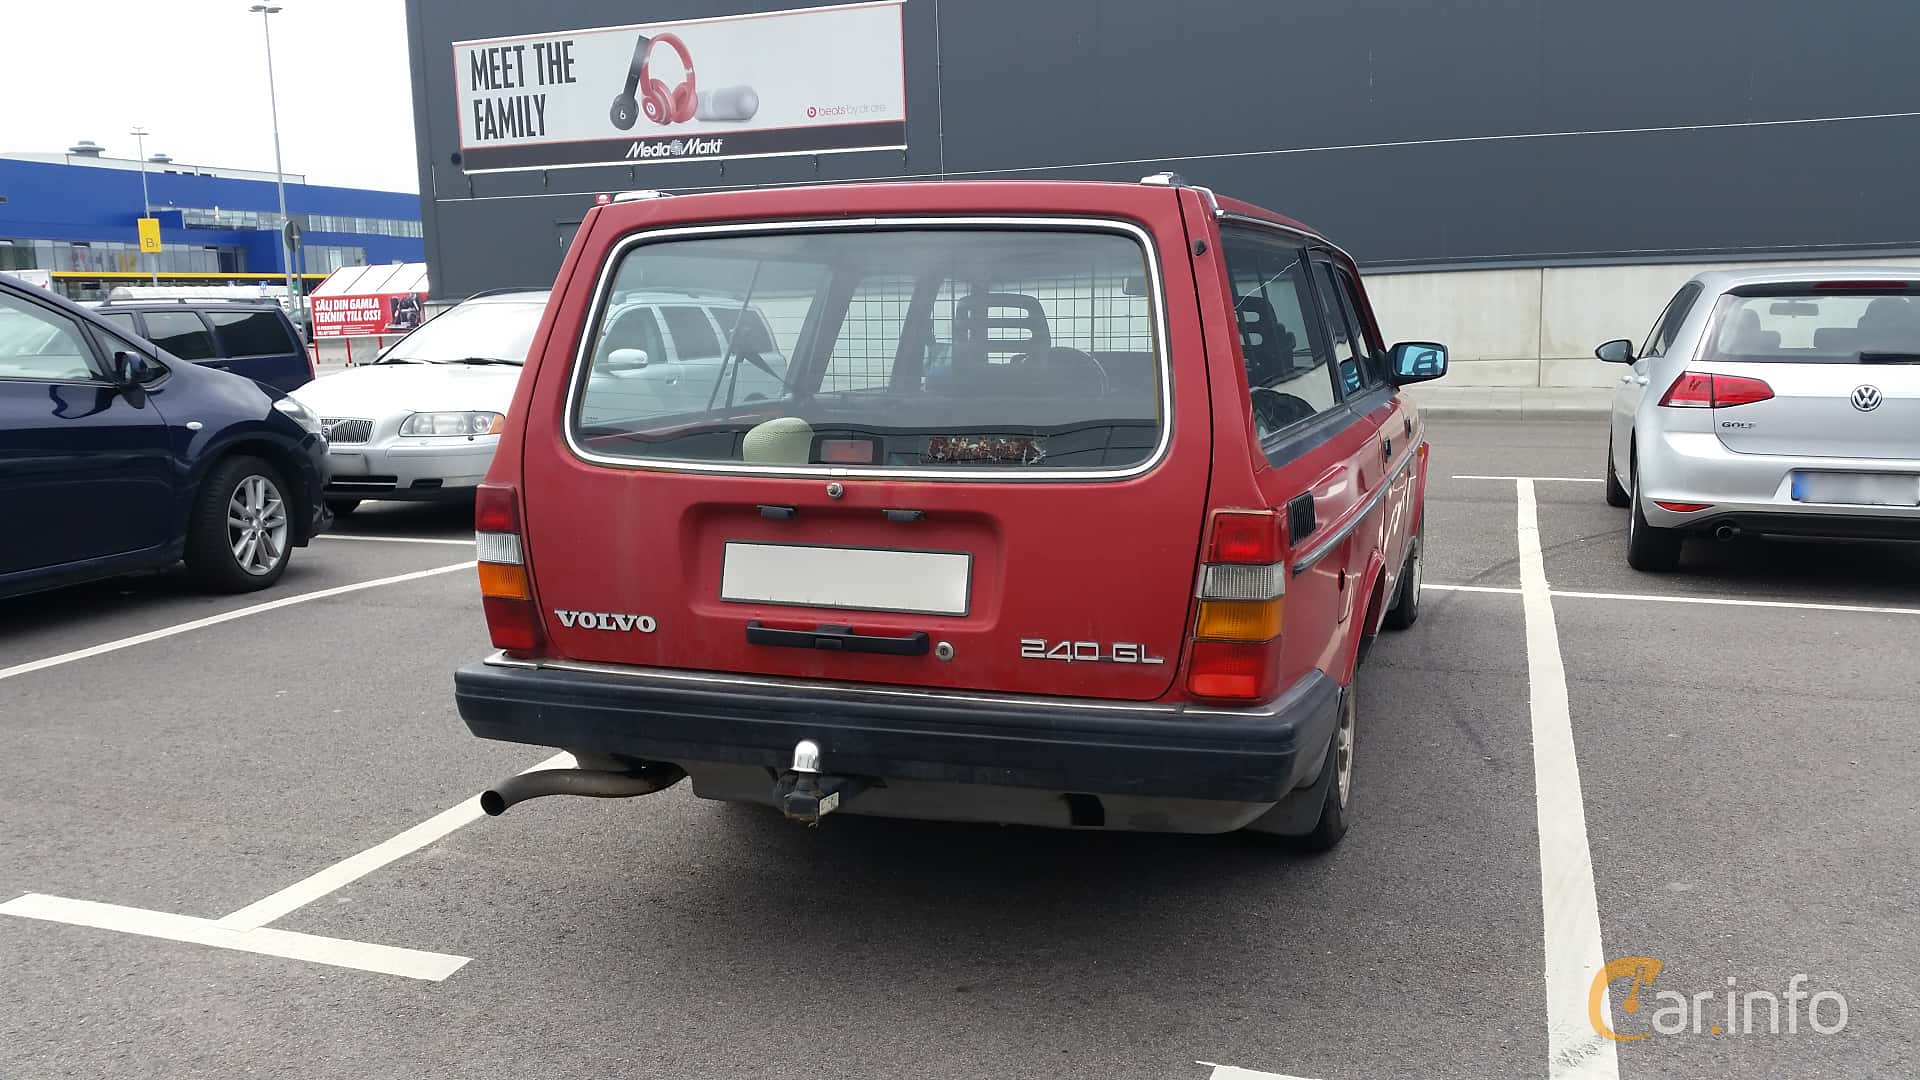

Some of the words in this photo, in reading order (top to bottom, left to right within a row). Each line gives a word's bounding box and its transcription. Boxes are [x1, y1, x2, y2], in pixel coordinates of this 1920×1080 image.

[470, 45, 525, 91] MEET
[533, 40, 577, 85] THE
[473, 94, 546, 140] FAMILY
[625, 141, 670, 158] Media
[681, 138, 722, 155] Markt
[315, 299, 332, 312] SÄLJ
[333, 300, 348, 310] DIN
[350, 298, 379, 309] GAMLA
[315, 312, 345, 322] TEKNIK
[345, 311, 362, 321] TILL
[363, 310, 381, 320] OSS!
[554, 609, 657, 633] VOLVO
[1021, 638, 1099, 663] 240
[1112, 643, 1164, 664] GL
